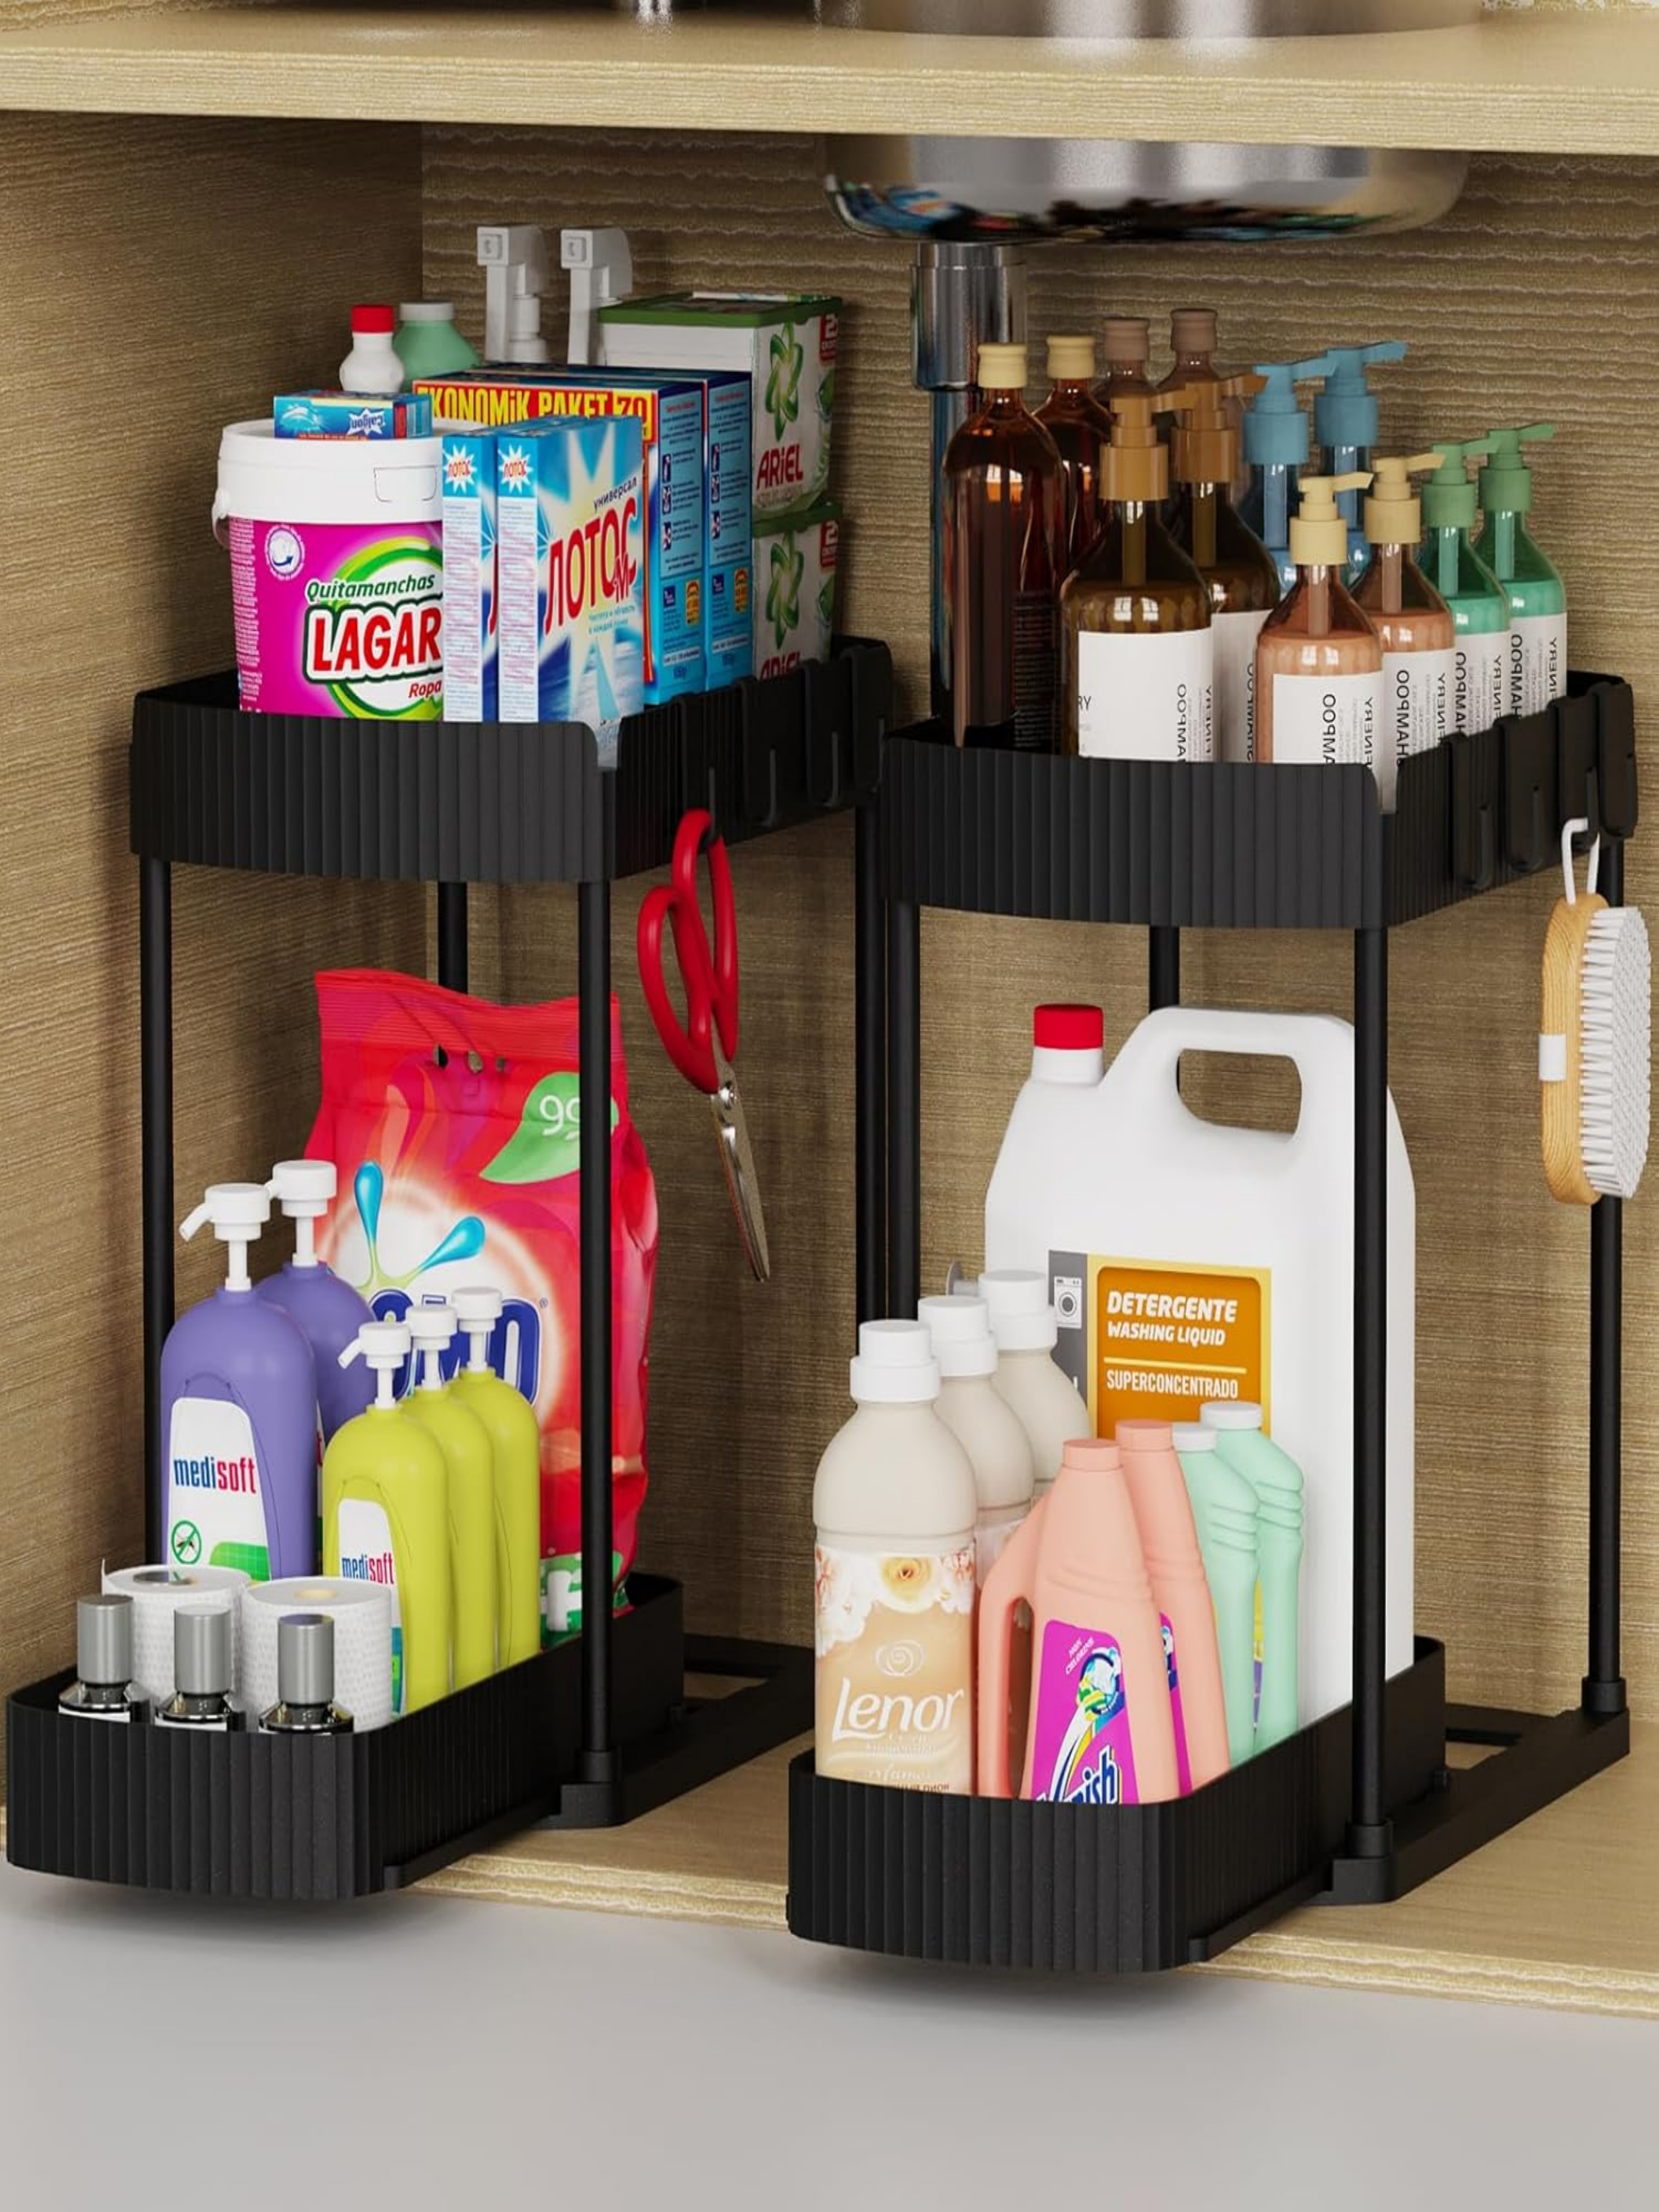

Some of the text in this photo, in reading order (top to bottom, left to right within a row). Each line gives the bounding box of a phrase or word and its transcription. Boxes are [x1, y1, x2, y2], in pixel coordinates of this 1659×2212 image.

[593, 477, 637, 513] универсал
[545, 496, 637, 635] ЛОТОС
[306, 574, 435, 602] Quitamanchas
[313, 607, 442, 671] LAGAR
[408, 679, 442, 698] Ropa
[1107, 1290, 1238, 1323] DETERGENTE
[1107, 1321, 1226, 1348] WASHING LIQUID
[1106, 1369, 1239, 1399] SUPERCONCENTRADO
[173, 1455, 257, 1494] medisoft
[341, 1552, 394, 1584] medisoft
[832, 1676, 965, 1743] Lenor
